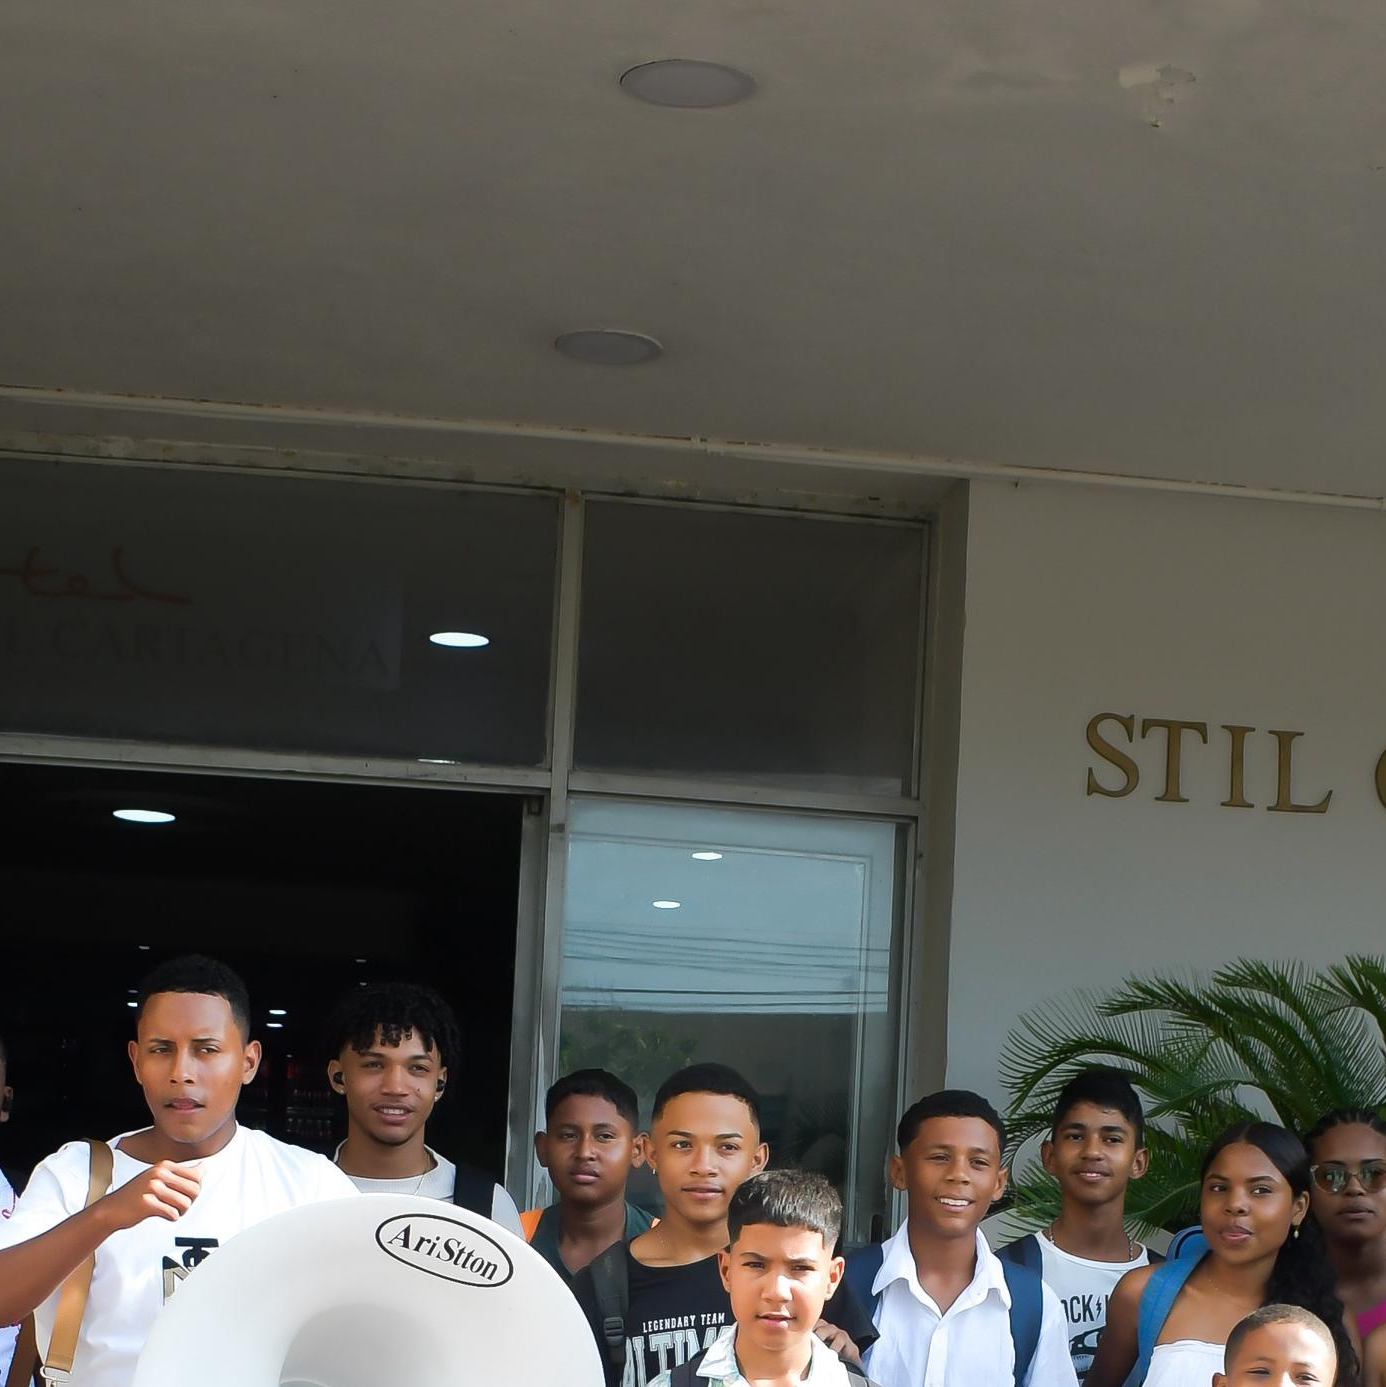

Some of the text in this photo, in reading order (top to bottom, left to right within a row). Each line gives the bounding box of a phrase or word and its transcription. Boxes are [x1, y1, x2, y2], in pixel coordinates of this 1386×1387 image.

[1085, 712, 1333, 814] STIL
[386, 1223, 499, 1281] AriStton
[642, 1312, 726, 1333] LEGENDARY TEAM
